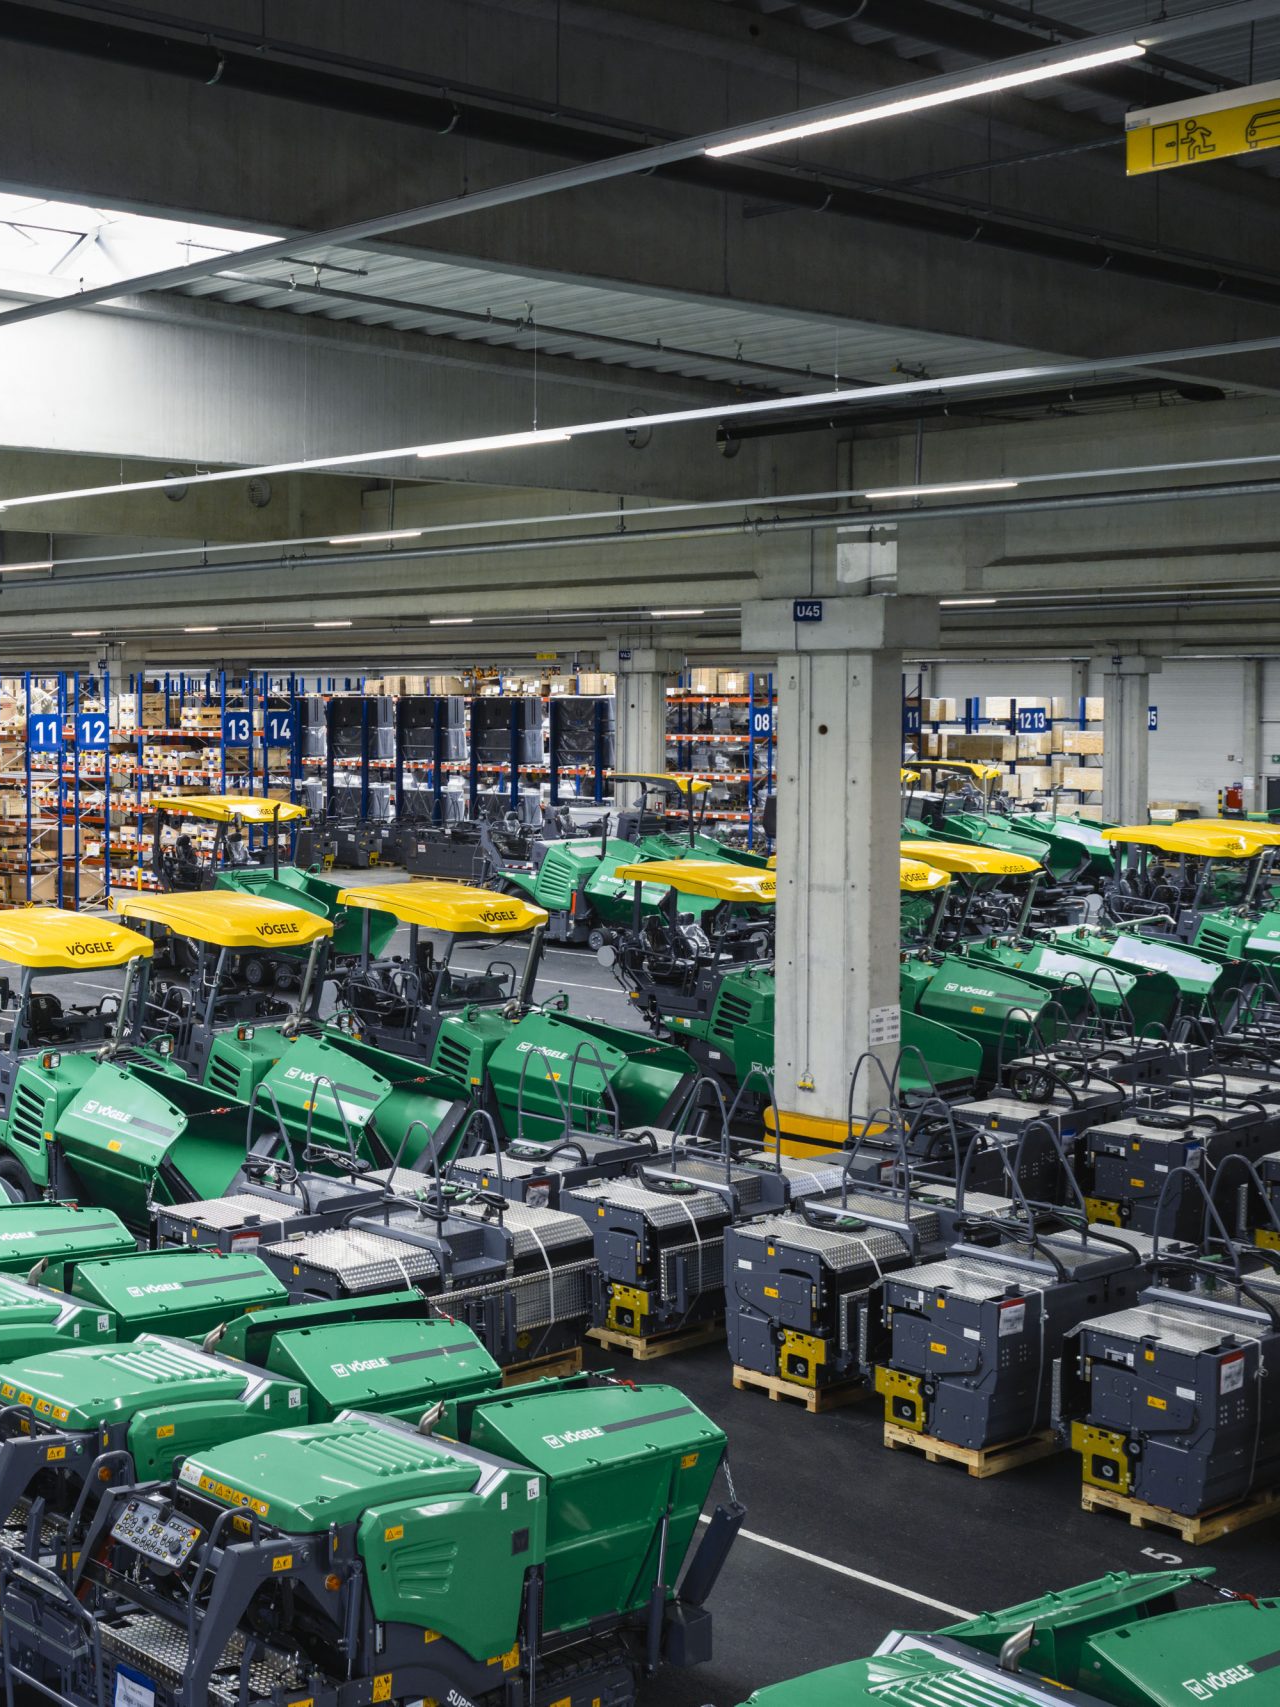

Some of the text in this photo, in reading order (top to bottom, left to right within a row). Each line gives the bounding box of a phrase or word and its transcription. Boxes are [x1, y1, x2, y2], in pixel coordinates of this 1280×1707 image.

[796, 605, 820, 617] U45
[270, 718, 292, 740] 14
[754, 713, 770, 732] 08
[1020, 713, 1045, 729] 12 13
[35, 721, 58, 745] 11
[81, 720, 105, 744] 12
[228, 719, 250, 741] 13
[479, 910, 518, 923] VÖGELE
[256, 922, 300, 937] VÖGELE
[66, 941, 115, 956] VÖGELE
[960, 985, 995, 997] VÖGELE
[97, 1105, 132, 1123] VÖGELE
[142, 1282, 183, 1294] VÖGELE
[346, 1357, 390, 1373] VÖGELE
[558, 1426, 605, 1443] VÖGELE
[1201, 1664, 1255, 1691] VÖGELE
